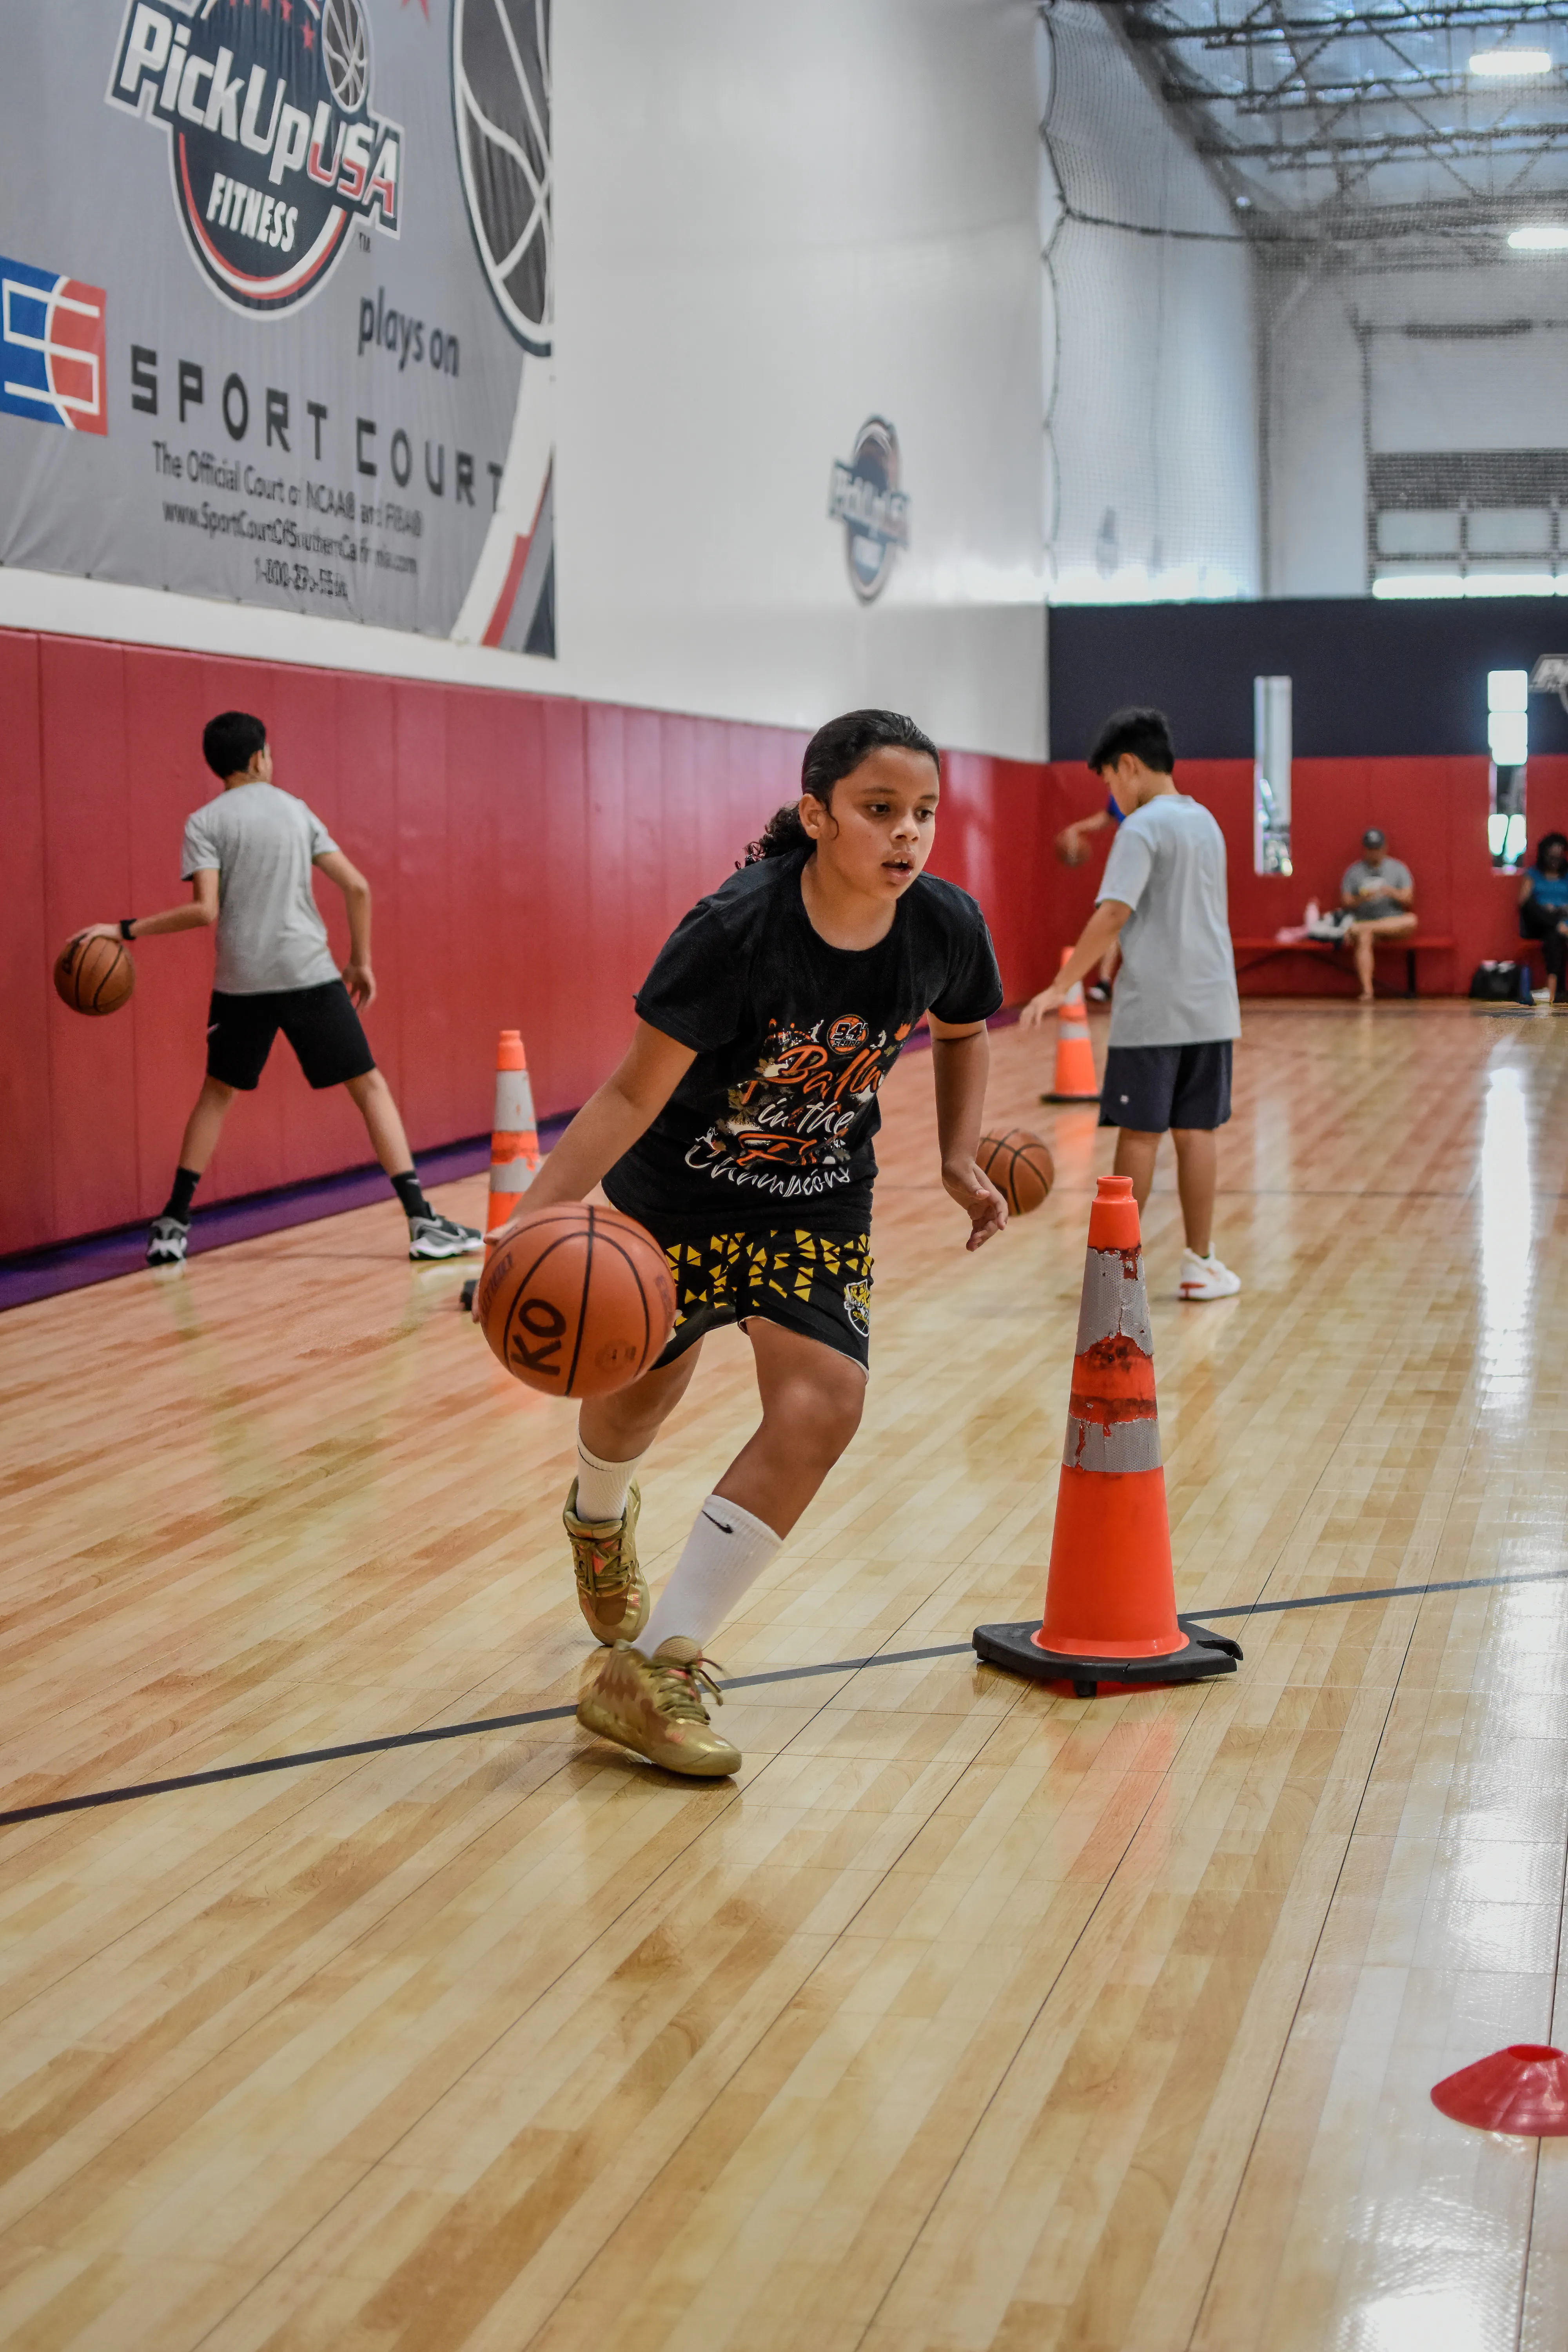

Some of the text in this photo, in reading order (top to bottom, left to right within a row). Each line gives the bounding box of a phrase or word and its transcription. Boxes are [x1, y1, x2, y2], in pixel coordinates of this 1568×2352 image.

[206, 172, 299, 252] FITNESS
[358, 286, 460, 377] plays on
[131, 343, 505, 514] SPORT COURT
[152, 440, 183, 479] The
[186, 450, 241, 491] Official
[243, 464, 285, 504] Court
[797, 1102, 855, 1134] the
[511, 1298, 566, 1376] KO
